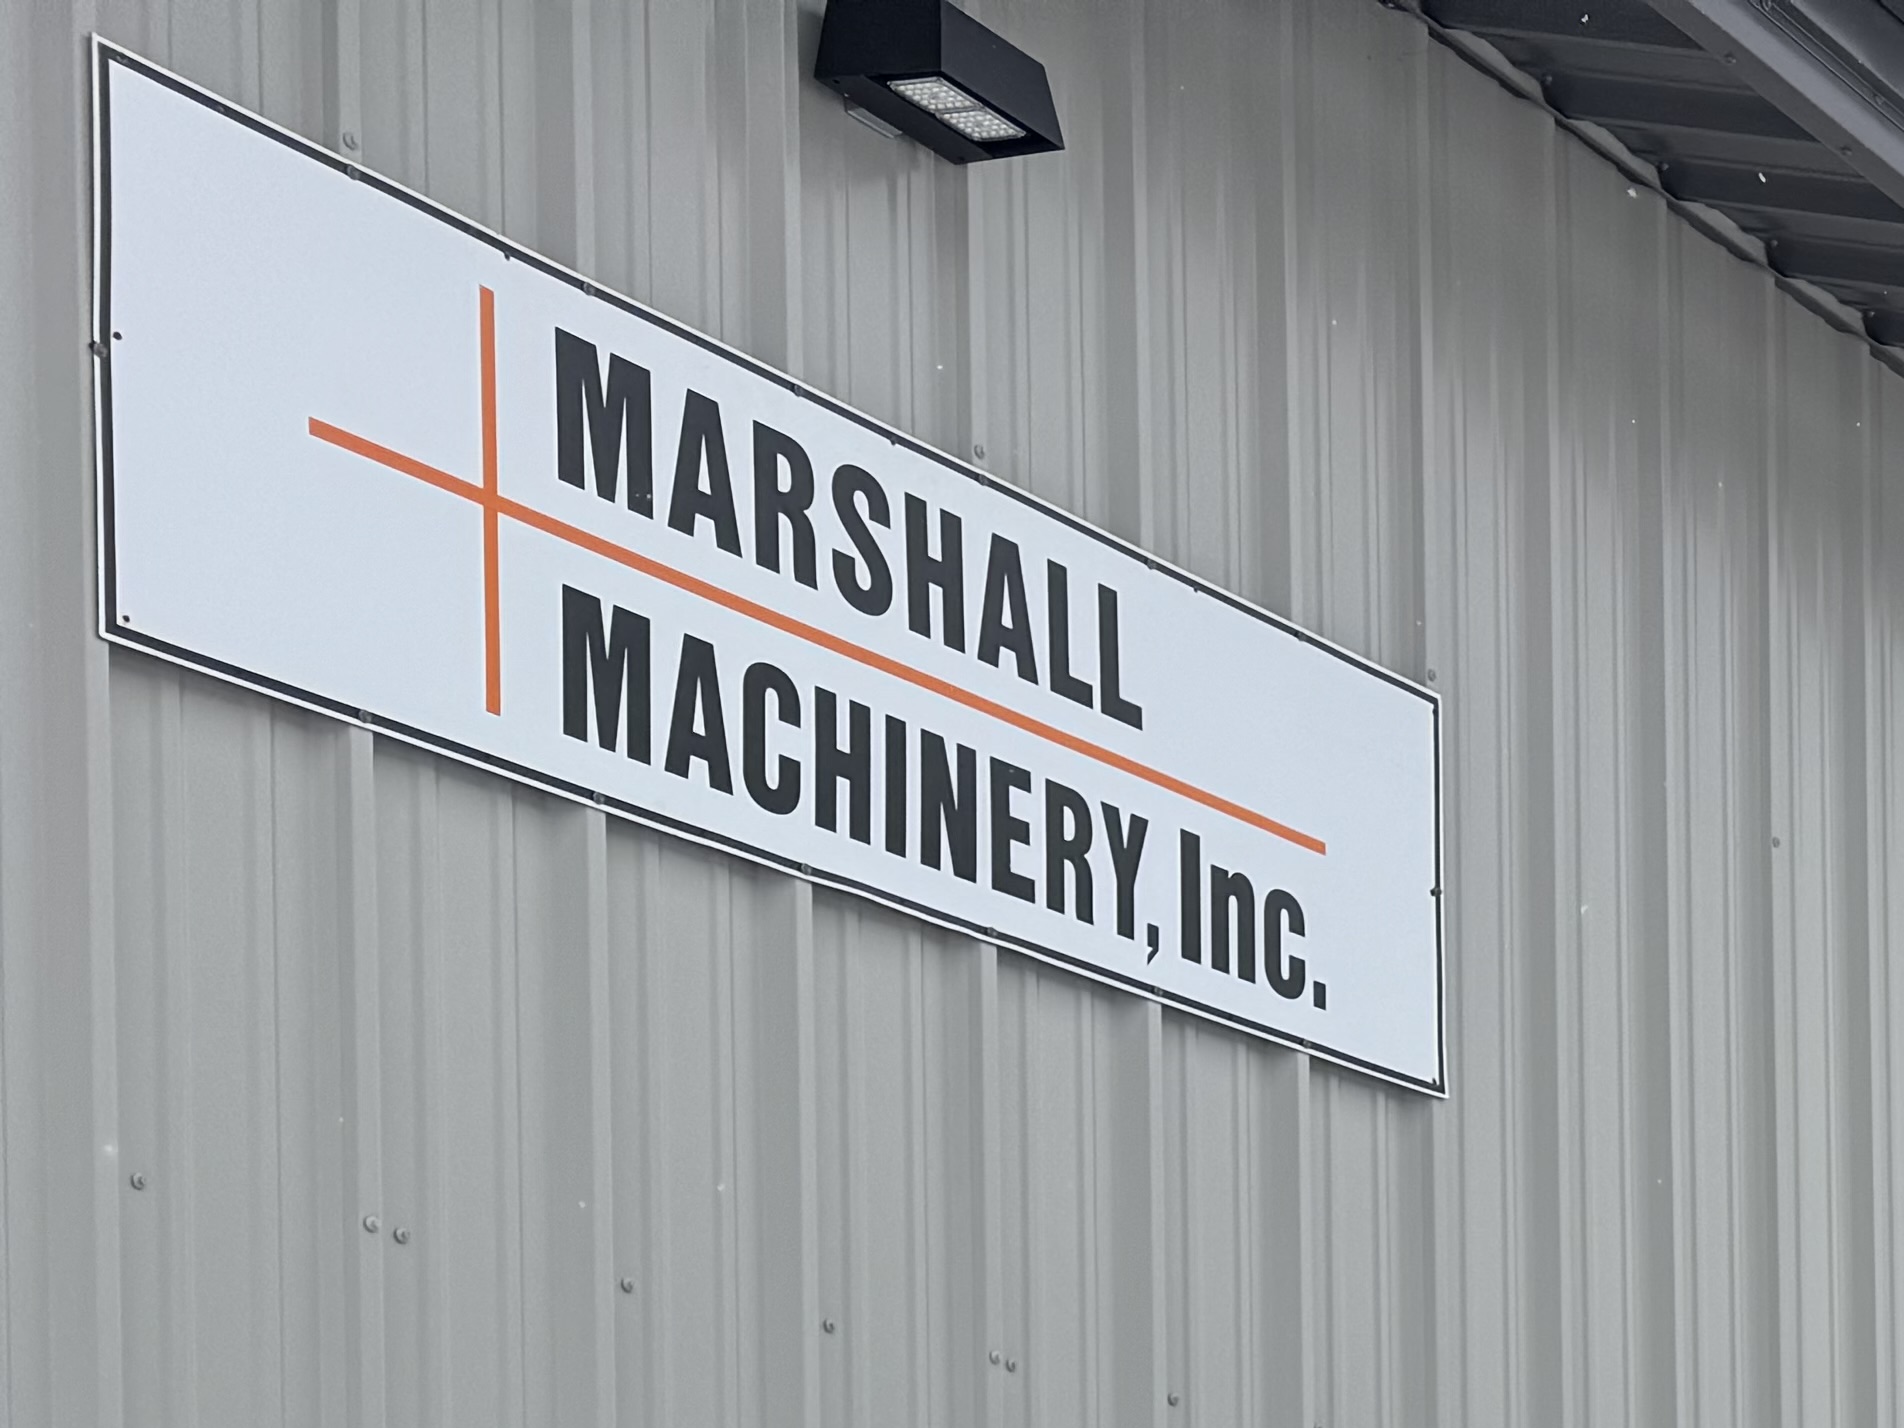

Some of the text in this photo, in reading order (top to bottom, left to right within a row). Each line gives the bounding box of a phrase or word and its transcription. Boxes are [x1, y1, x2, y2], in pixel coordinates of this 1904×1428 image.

[554, 325, 1144, 732] MARSHALL
[561, 582, 1328, 1012] MACHINERY, Inc.
